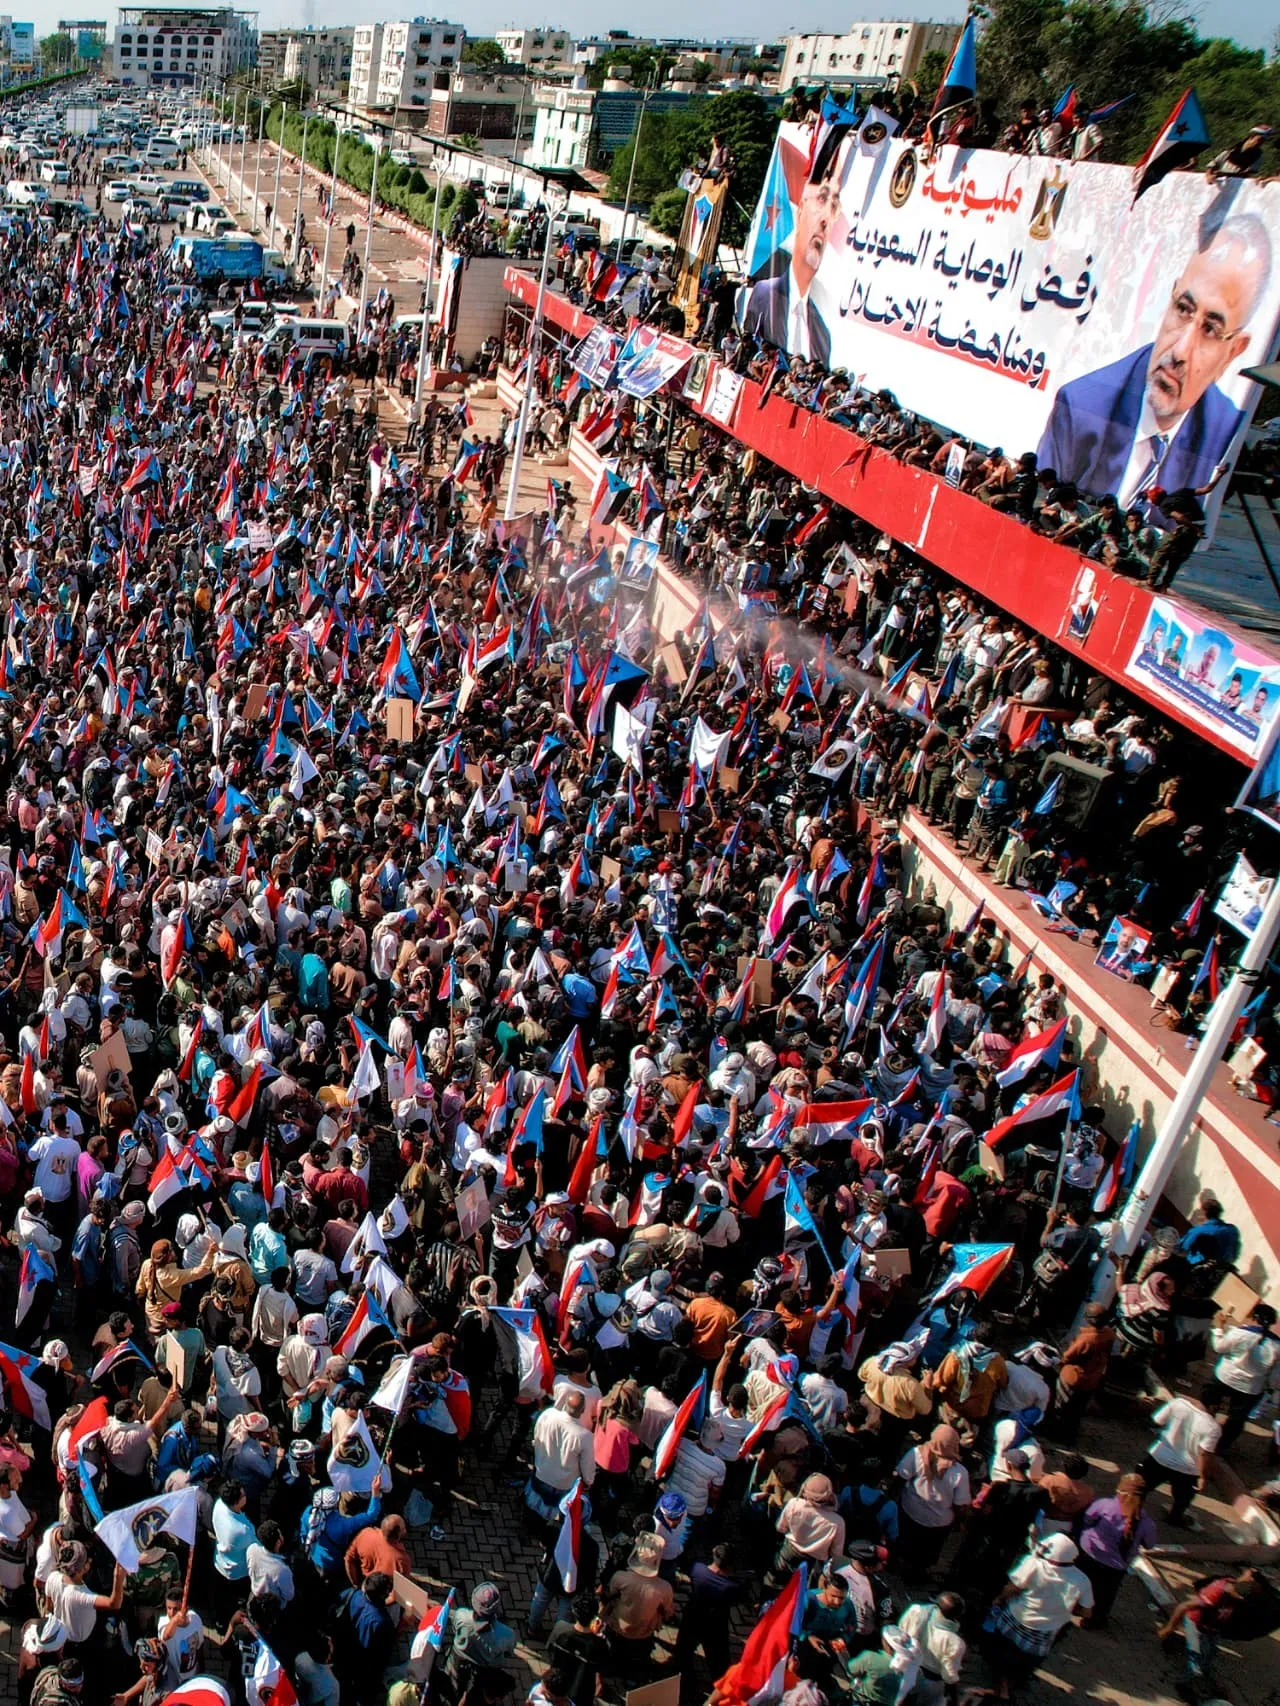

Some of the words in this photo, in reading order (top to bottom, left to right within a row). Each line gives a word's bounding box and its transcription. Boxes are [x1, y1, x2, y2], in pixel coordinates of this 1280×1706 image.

[922, 157, 1023, 223] مليونية
[846, 211, 931, 269] السعودية
[932, 230, 1023, 301] الوصاية
[838, 278, 927, 331] الاحتلال
[1021, 253, 1098, 325] رفض
[927, 301, 1047, 389] ومناهضة
